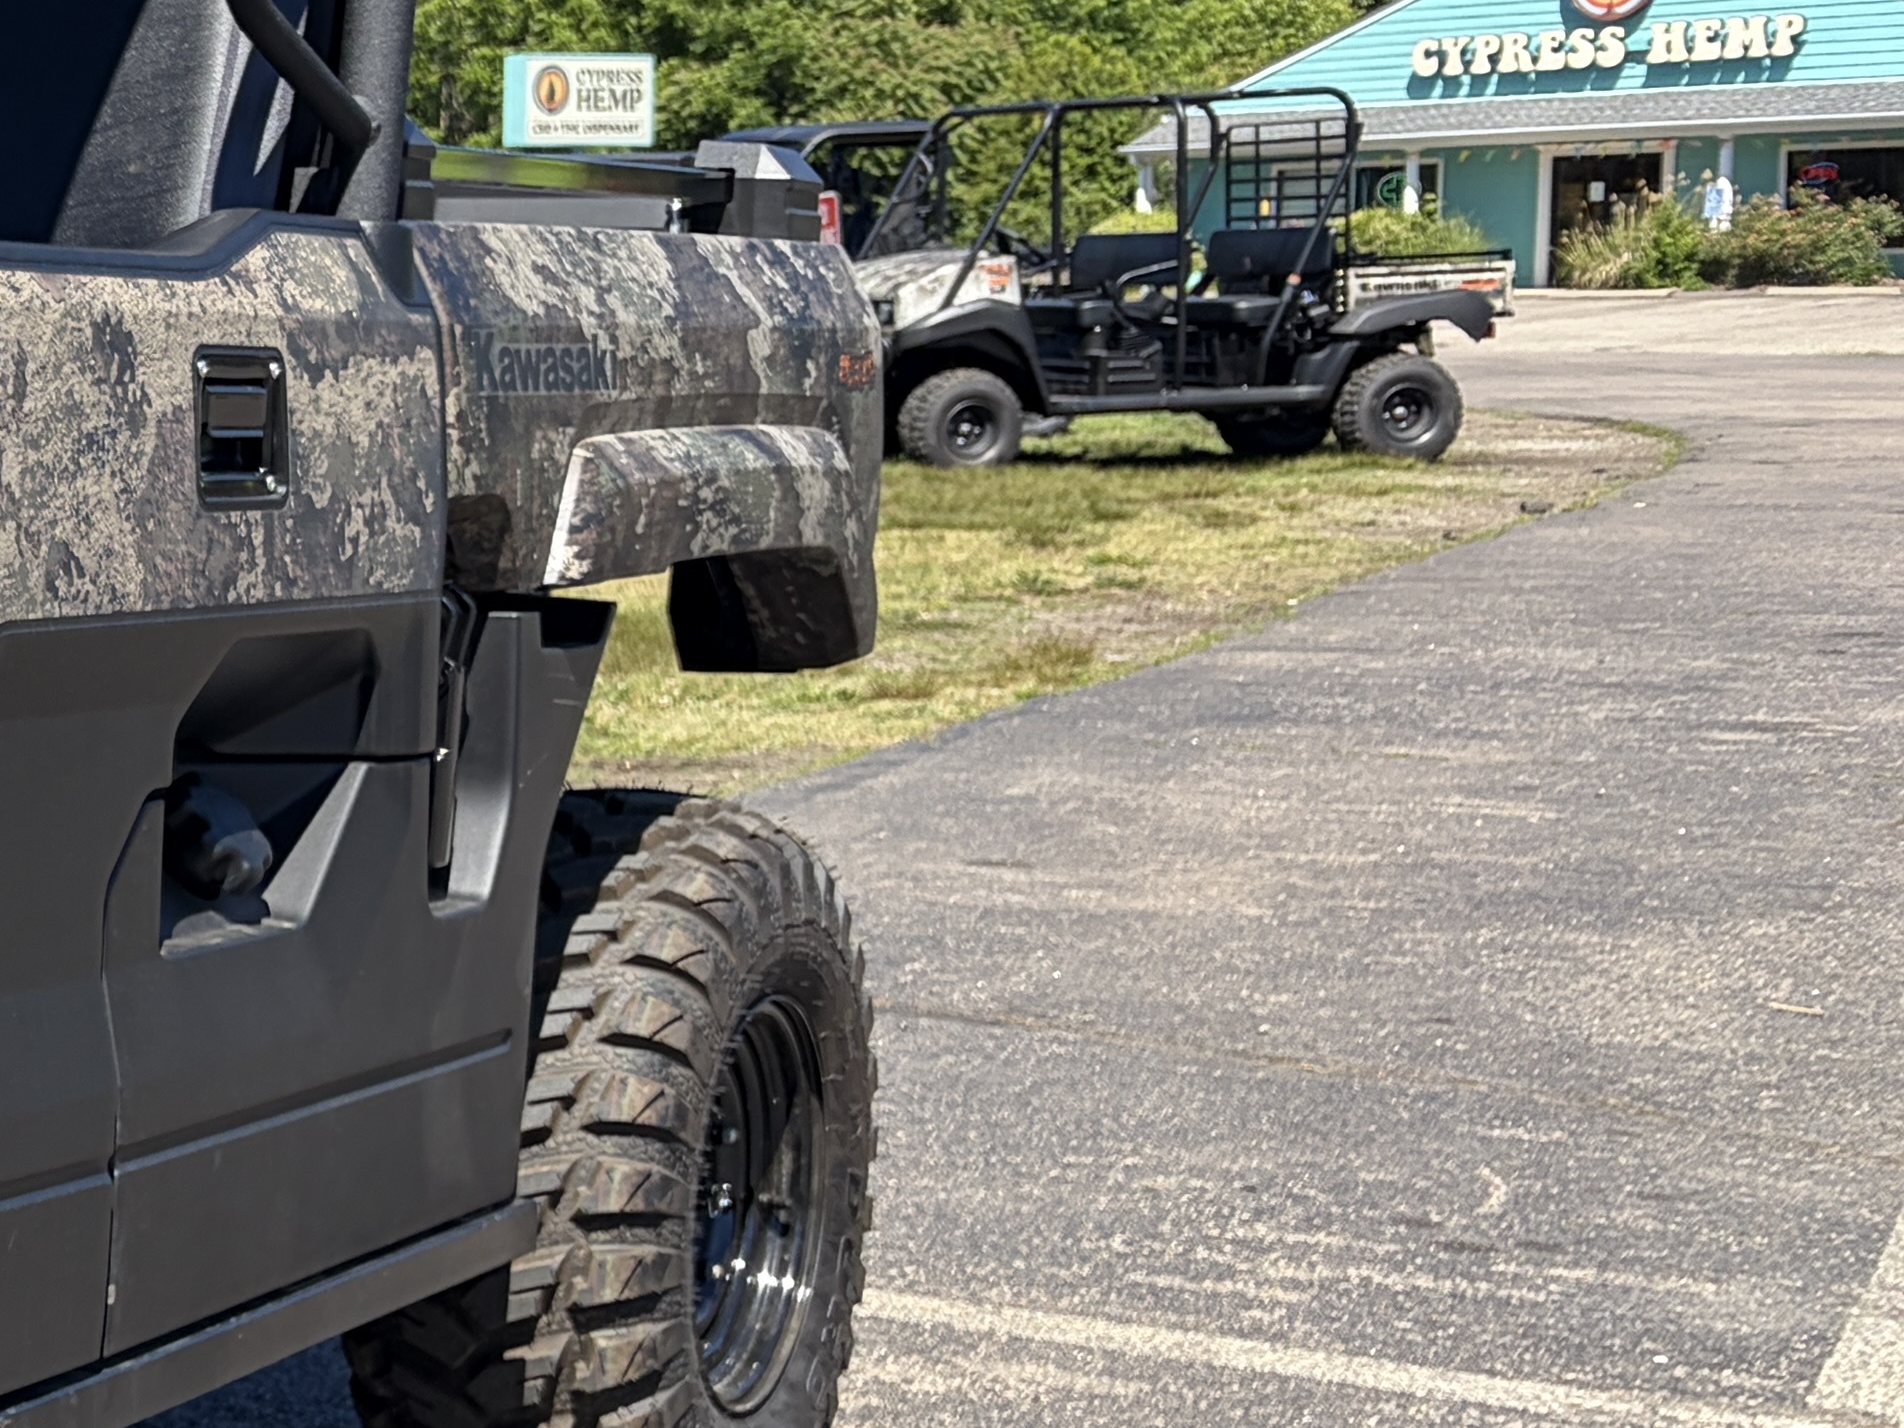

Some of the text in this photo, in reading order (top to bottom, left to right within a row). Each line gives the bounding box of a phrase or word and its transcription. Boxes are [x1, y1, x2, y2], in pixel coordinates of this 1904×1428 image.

[1411, 13, 1808, 78] CYPRESS HEMP
[575, 68, 643, 85] CYPRESS
[576, 87, 642, 112] HEMP
[474, 330, 619, 393] Kawasaki
